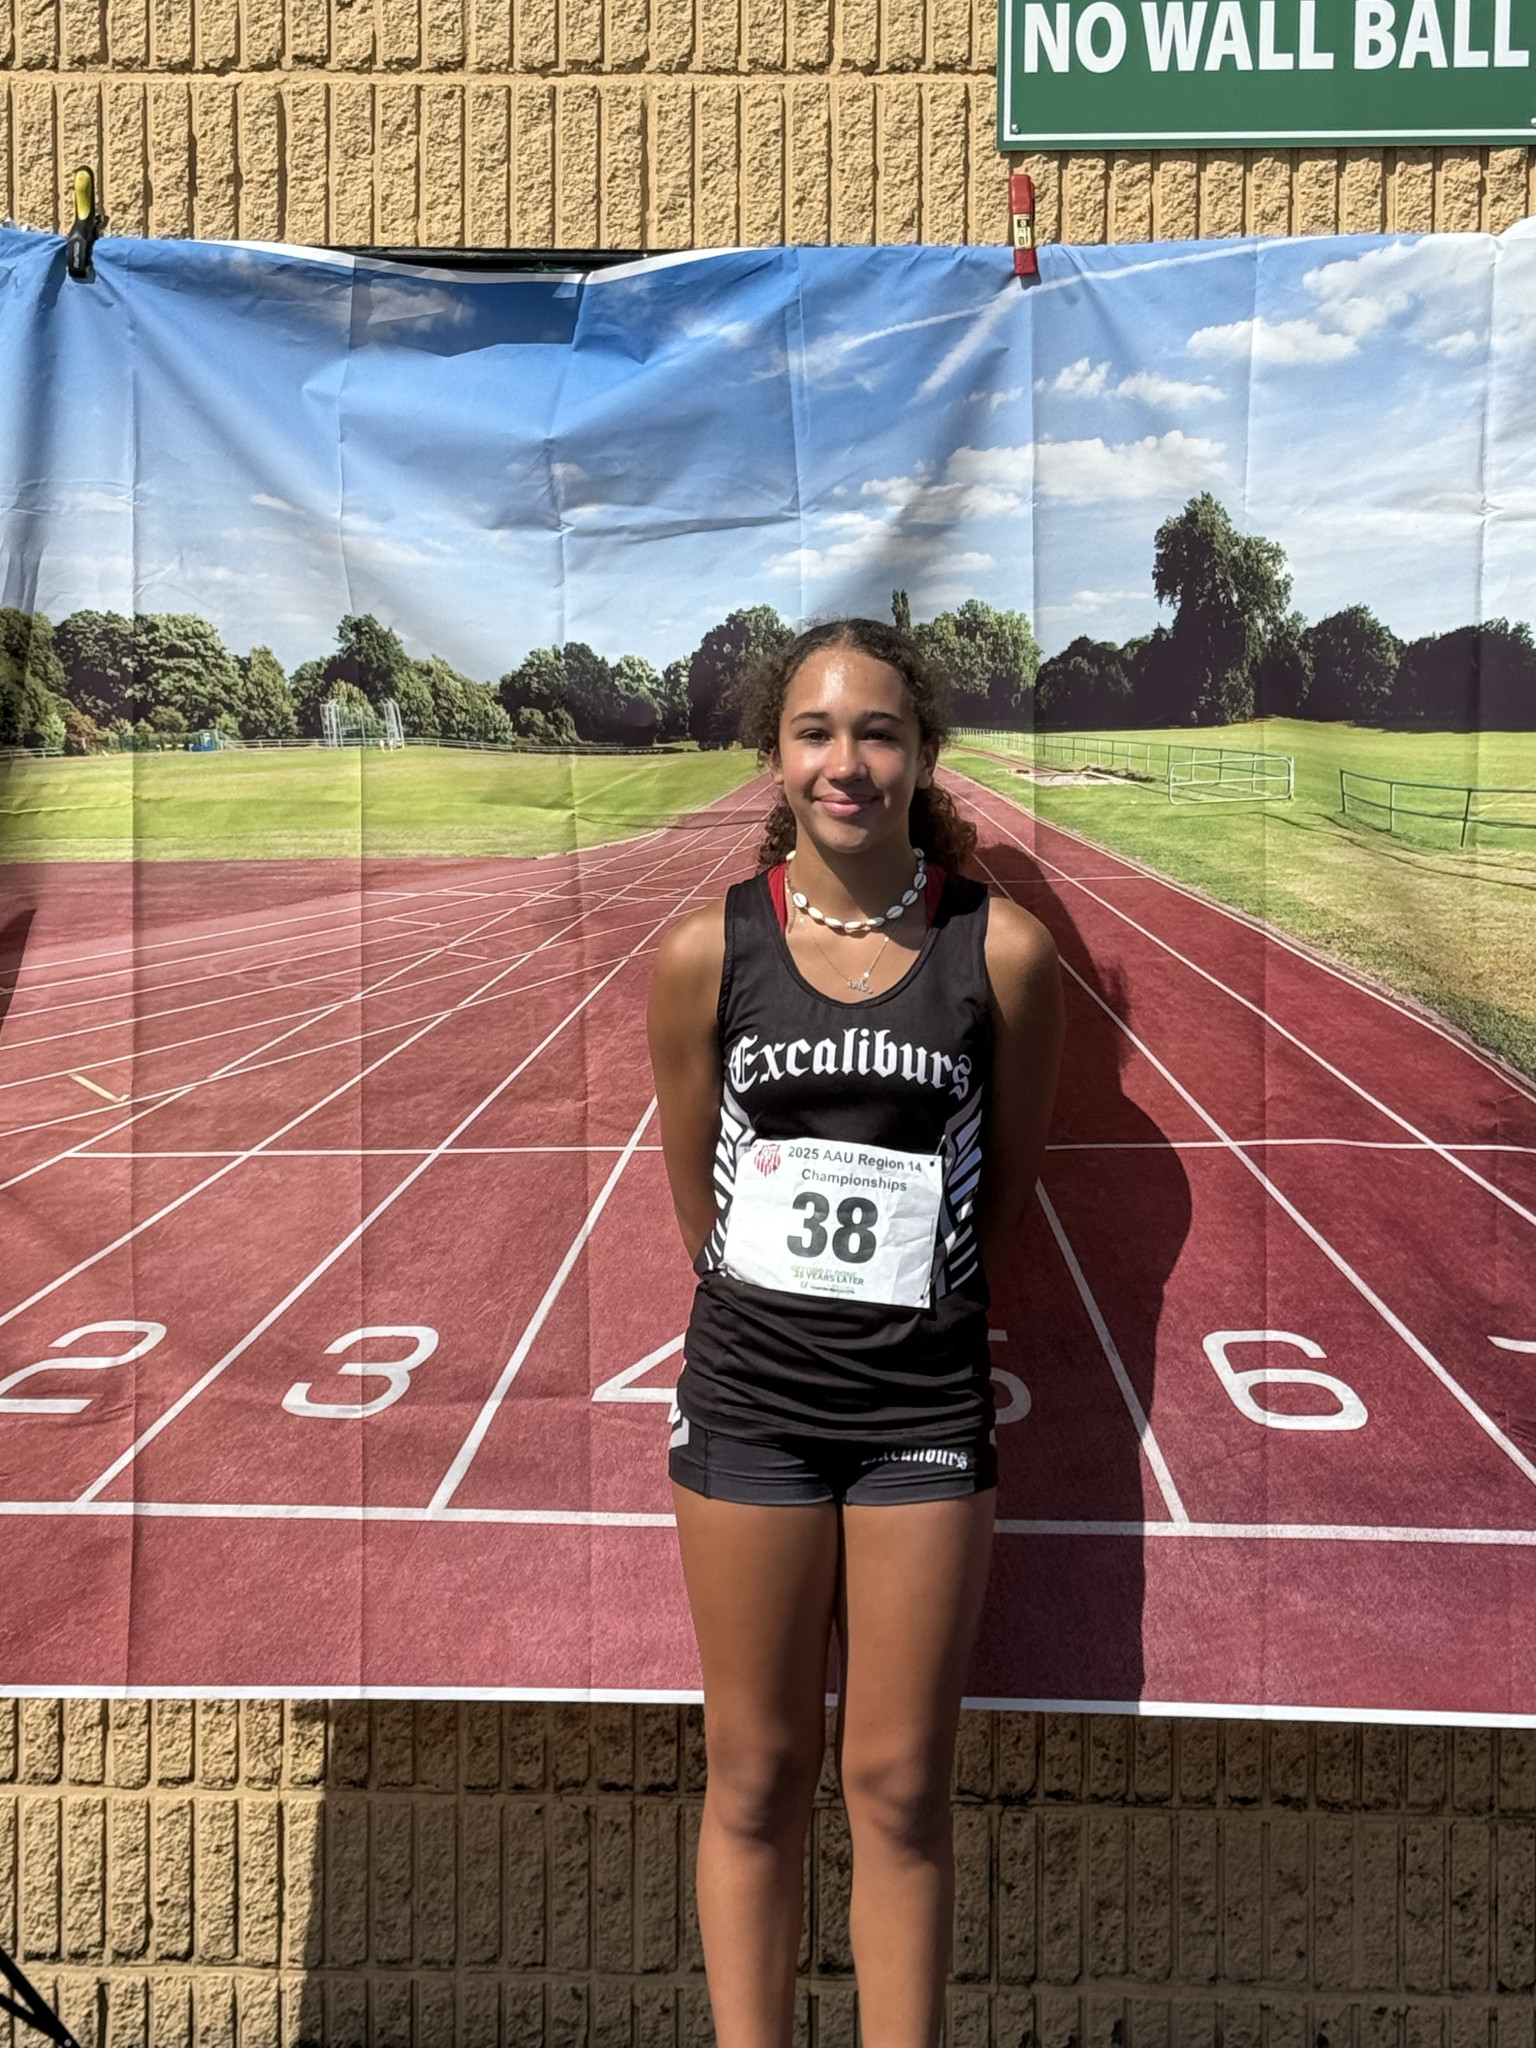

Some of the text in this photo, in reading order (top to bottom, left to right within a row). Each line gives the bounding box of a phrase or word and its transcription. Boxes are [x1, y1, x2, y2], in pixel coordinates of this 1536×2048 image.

[1024, 0, 1530, 73] NO WALL BALL
[728, 1027, 972, 1100] Excaliburs
[788, 1146, 819, 1160] 2025
[823, 1149, 854, 1164] AAU
[858, 1153, 905, 1171] Region
[907, 1160, 922, 1173] 14
[801, 1168, 908, 1193] Championships
[787, 1191, 879, 1264] 38
[806, 1270, 835, 1282] YEARS
[836, 1275, 865, 1287] LATER
[0, 1320, 167, 1413] 2
[281, 1325, 440, 1419] 3
[1202, 1330, 1368, 1430] 6
